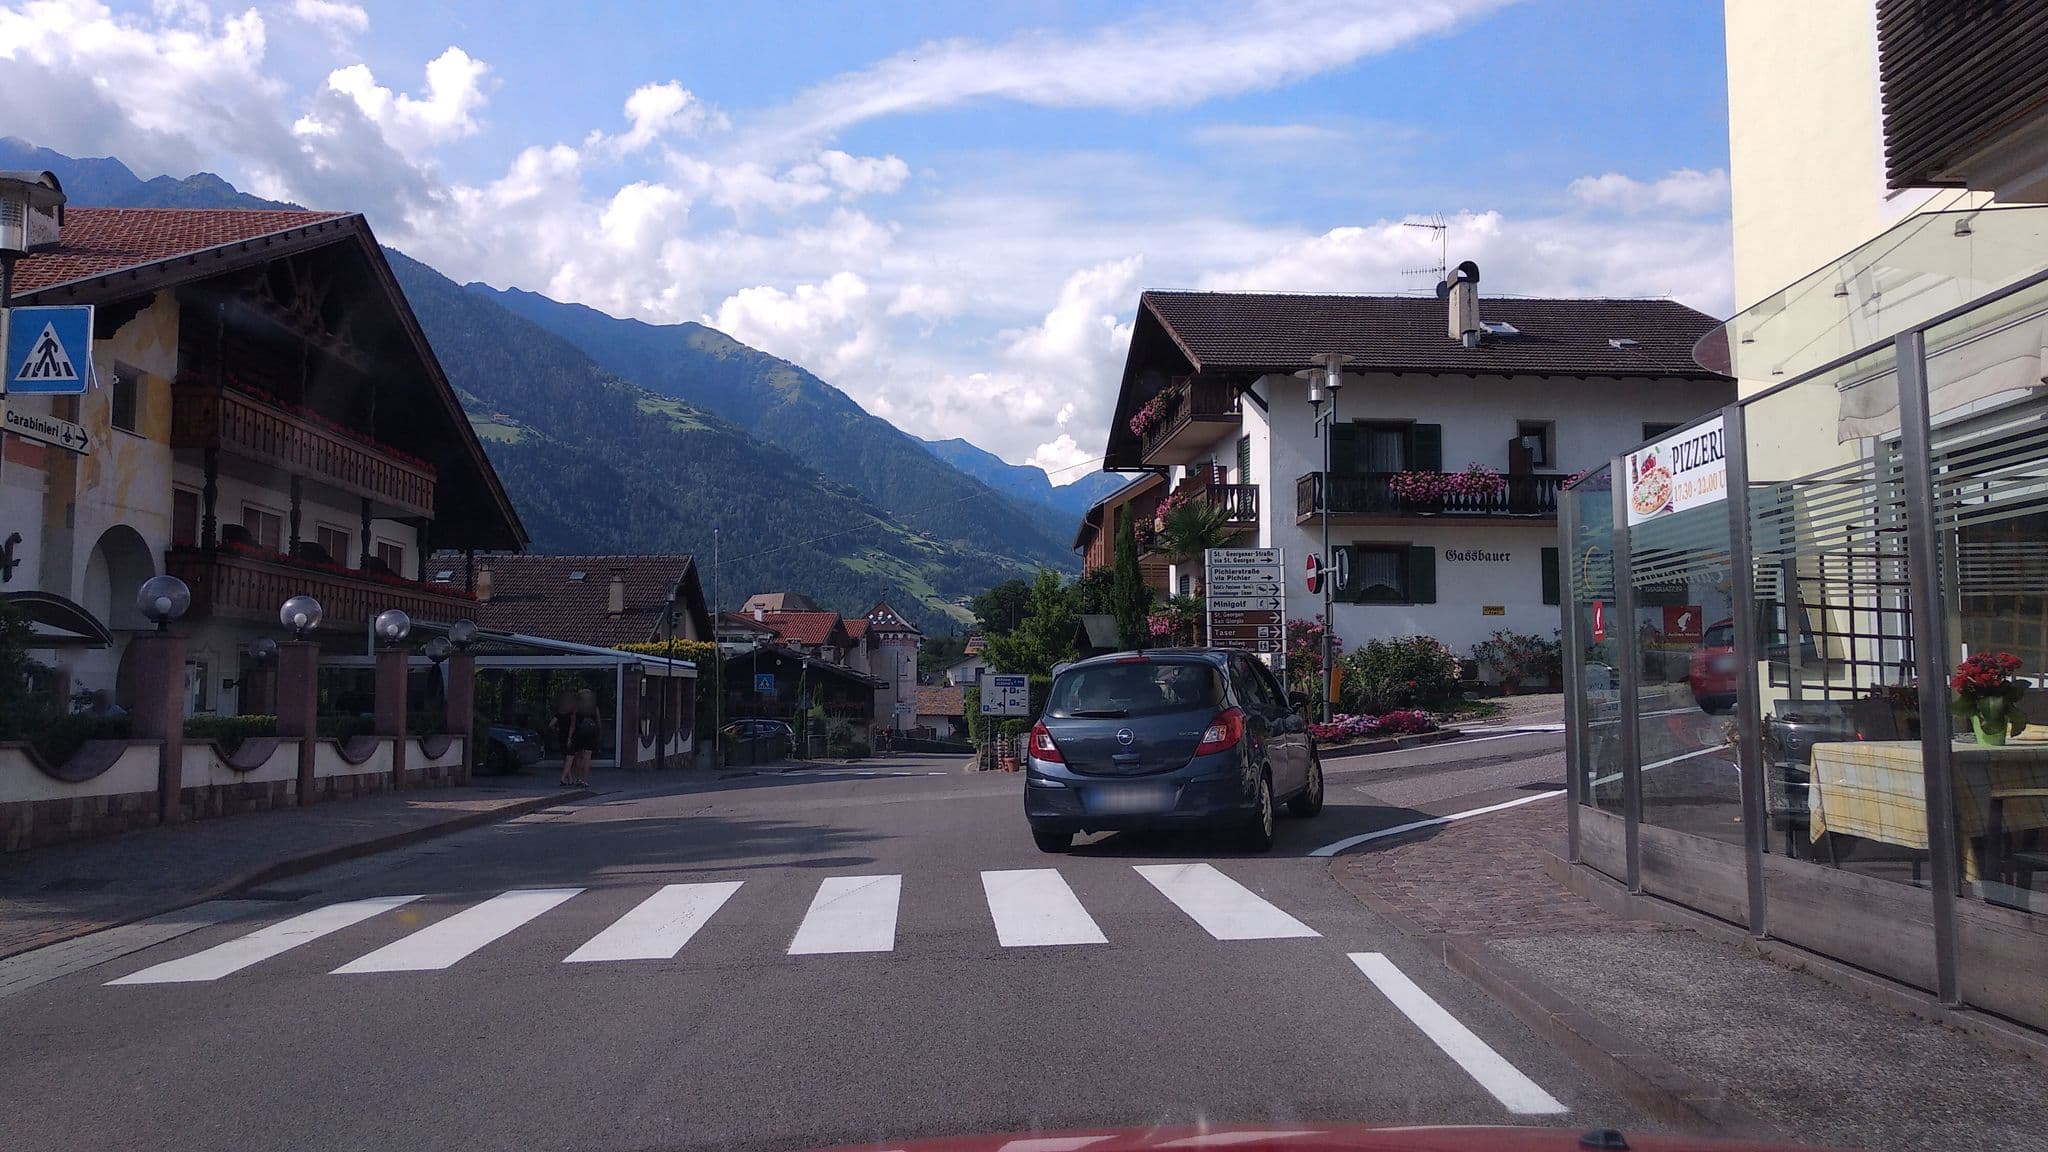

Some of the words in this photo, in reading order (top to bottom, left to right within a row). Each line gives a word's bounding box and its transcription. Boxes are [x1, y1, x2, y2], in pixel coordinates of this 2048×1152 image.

[6, 410, 59, 437] Carabinieri
[1672, 428, 1726, 476] PIZZERI
[1674, 481, 1693, 502] 17.30
[1698, 473, 1718, 495] 22.00
[1445, 549, 1511, 562] Gassbauer
[1213, 600, 1247, 609] Minigolf
